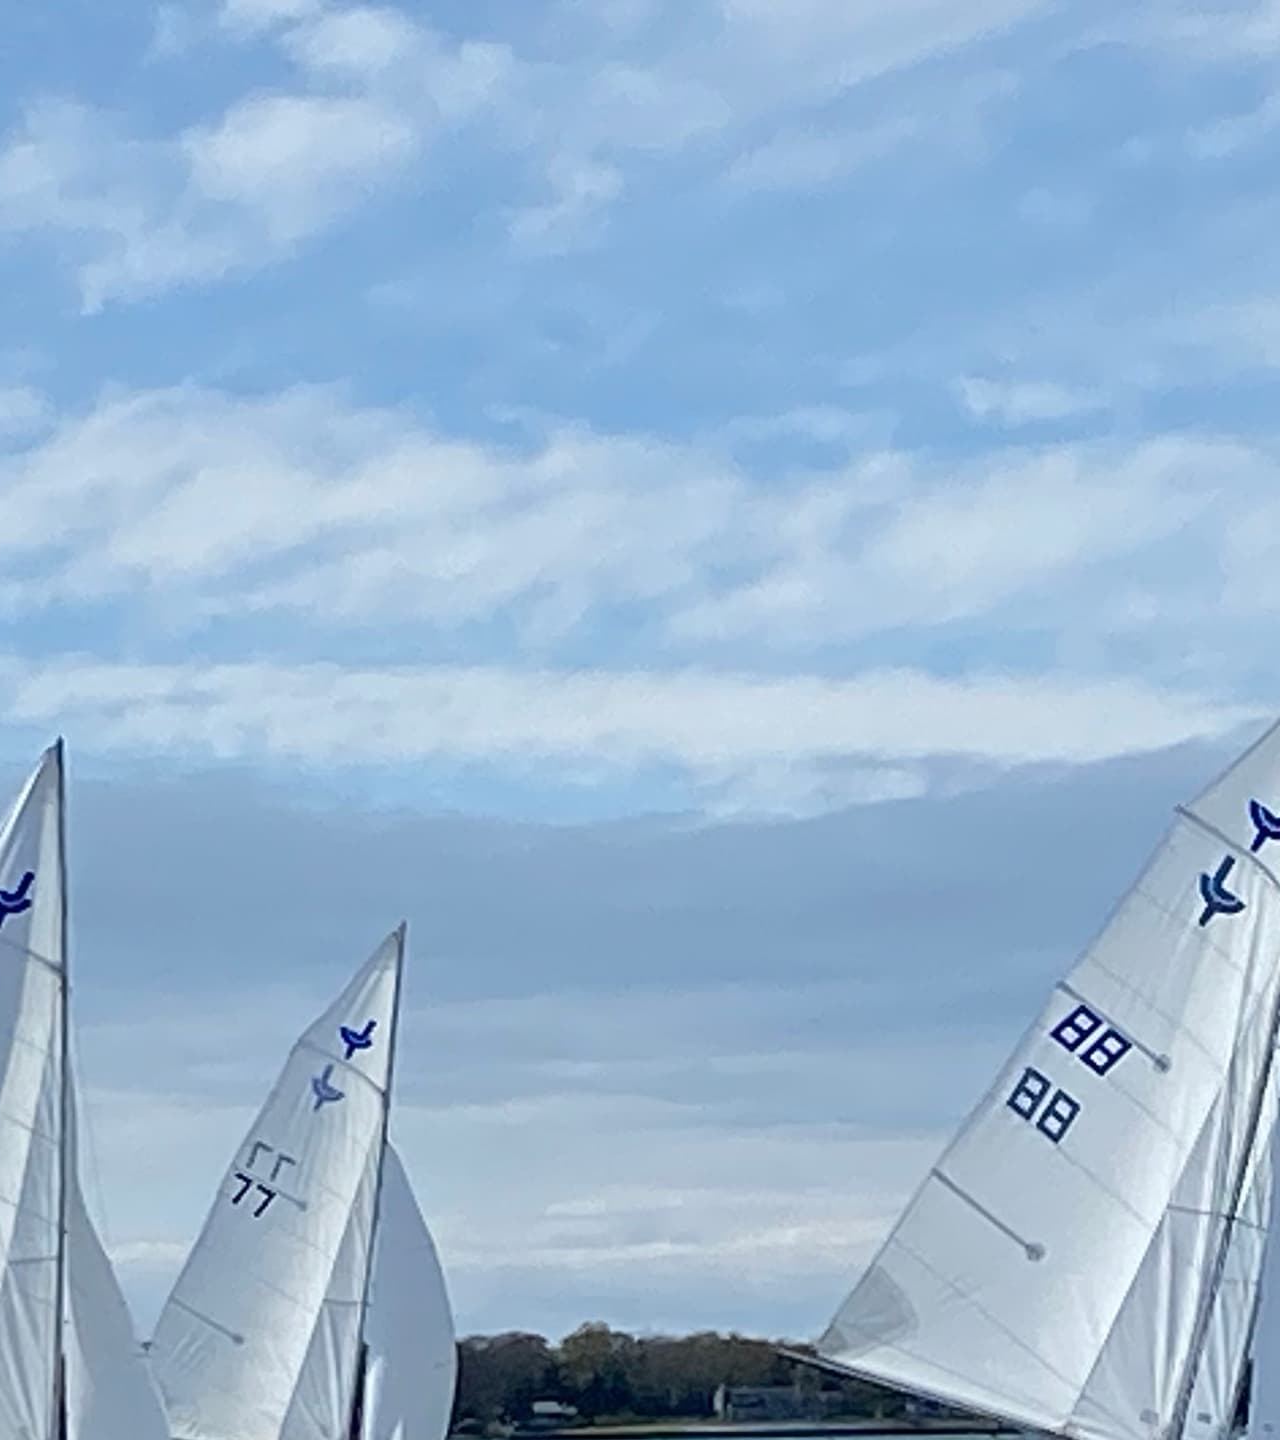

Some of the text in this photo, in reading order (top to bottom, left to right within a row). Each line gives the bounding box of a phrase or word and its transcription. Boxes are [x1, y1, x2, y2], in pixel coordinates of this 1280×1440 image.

[1050, 1004, 1133, 1077] 88
[1006, 1066, 1081, 1144] 88
[232, 1173, 277, 1218] 77
